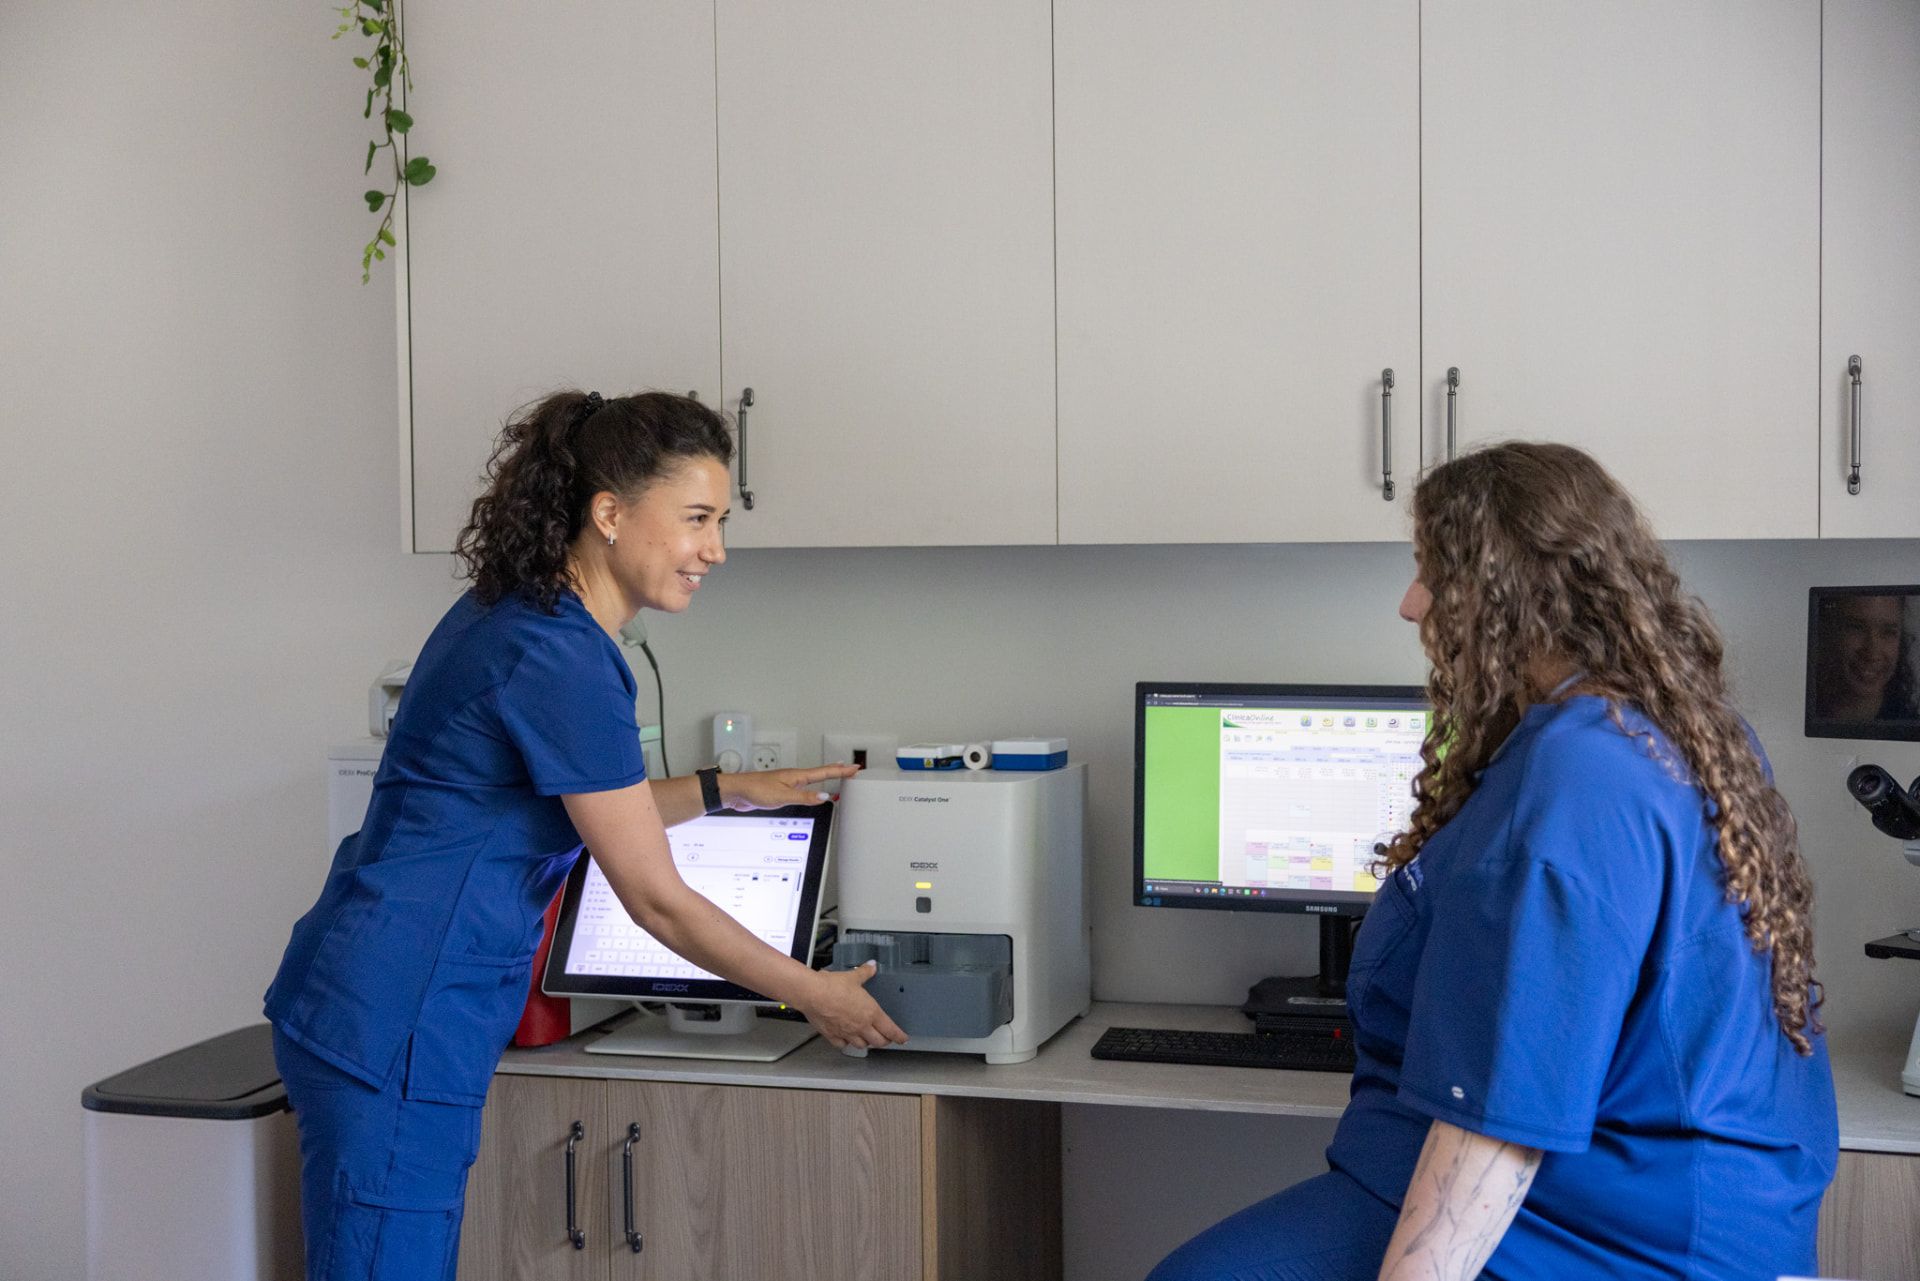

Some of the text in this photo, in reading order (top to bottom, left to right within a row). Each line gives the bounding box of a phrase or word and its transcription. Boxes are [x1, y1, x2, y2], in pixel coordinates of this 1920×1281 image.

[910, 861, 938, 869] IDEXX
[1305, 905, 1338, 913] SAMSUNG
[651, 982, 690, 992] IDEXX
